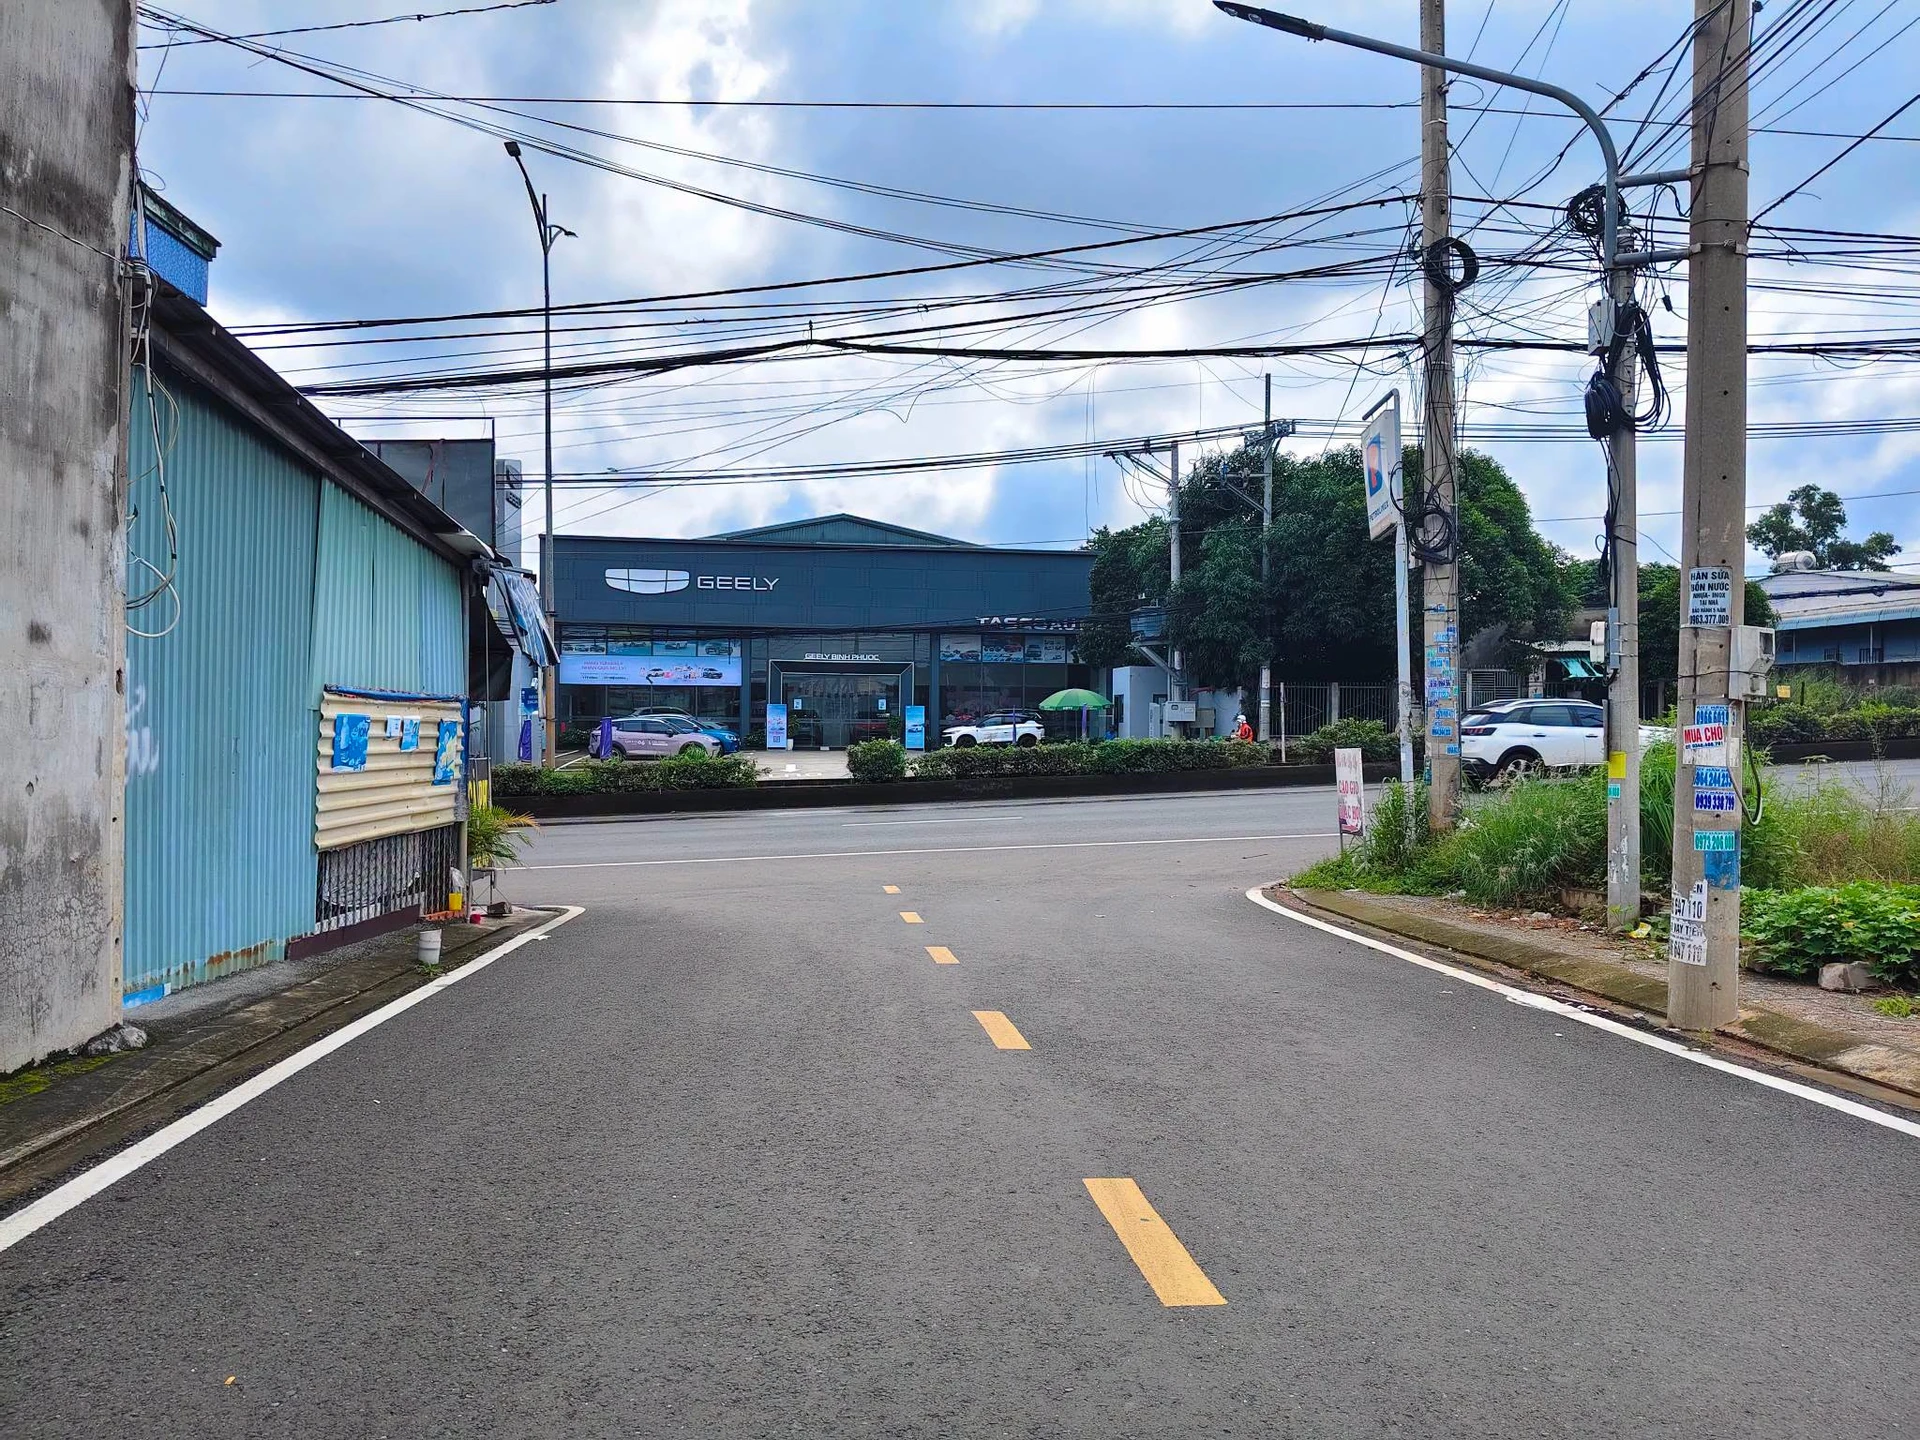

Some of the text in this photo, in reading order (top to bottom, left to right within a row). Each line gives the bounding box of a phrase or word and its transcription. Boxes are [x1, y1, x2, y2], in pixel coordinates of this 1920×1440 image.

[1711, 569, 1730, 580] SỬA
[696, 576, 779, 590] GEELY
[1684, 723, 1723, 744] MUA CHÓ
